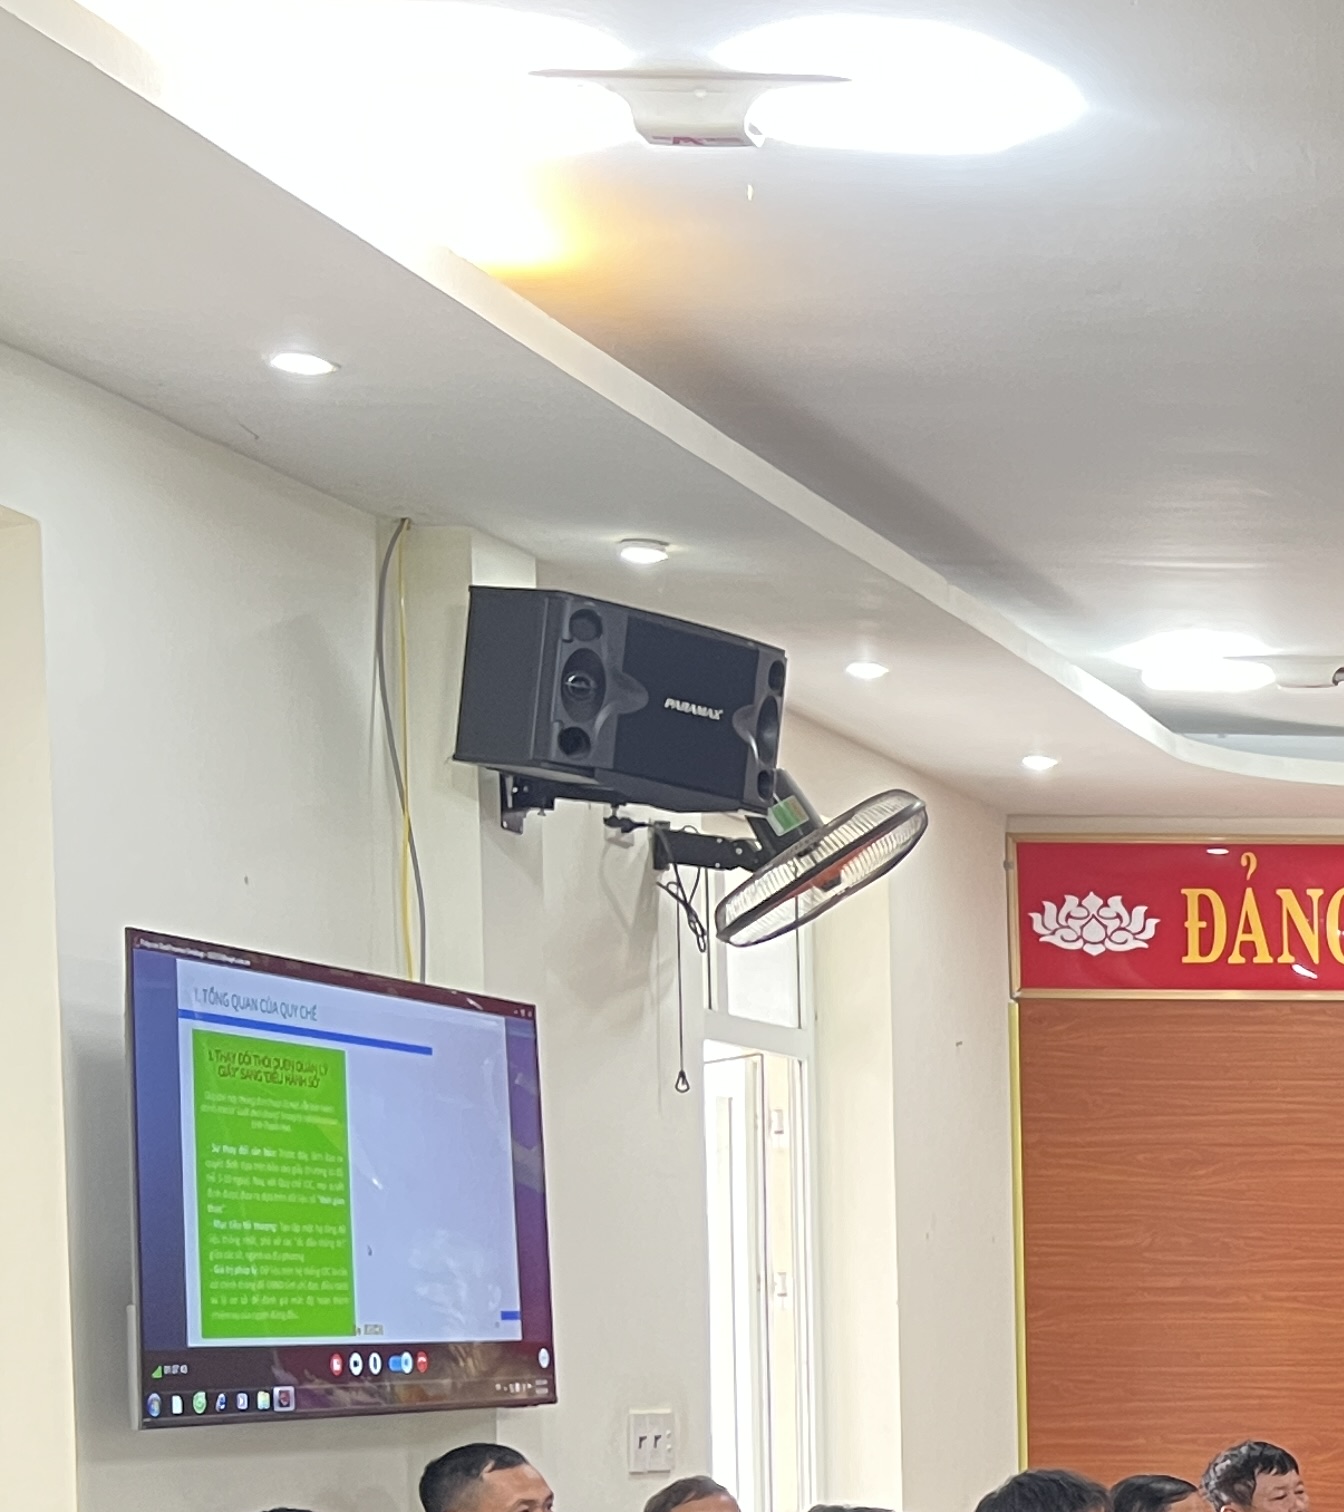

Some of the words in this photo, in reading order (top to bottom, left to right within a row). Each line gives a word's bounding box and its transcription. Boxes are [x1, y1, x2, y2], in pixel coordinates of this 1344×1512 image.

[664, 697, 722, 721] PARAMAX
[231, 993, 258, 1013] QUAN
[279, 1001, 298, 1020] QUY
